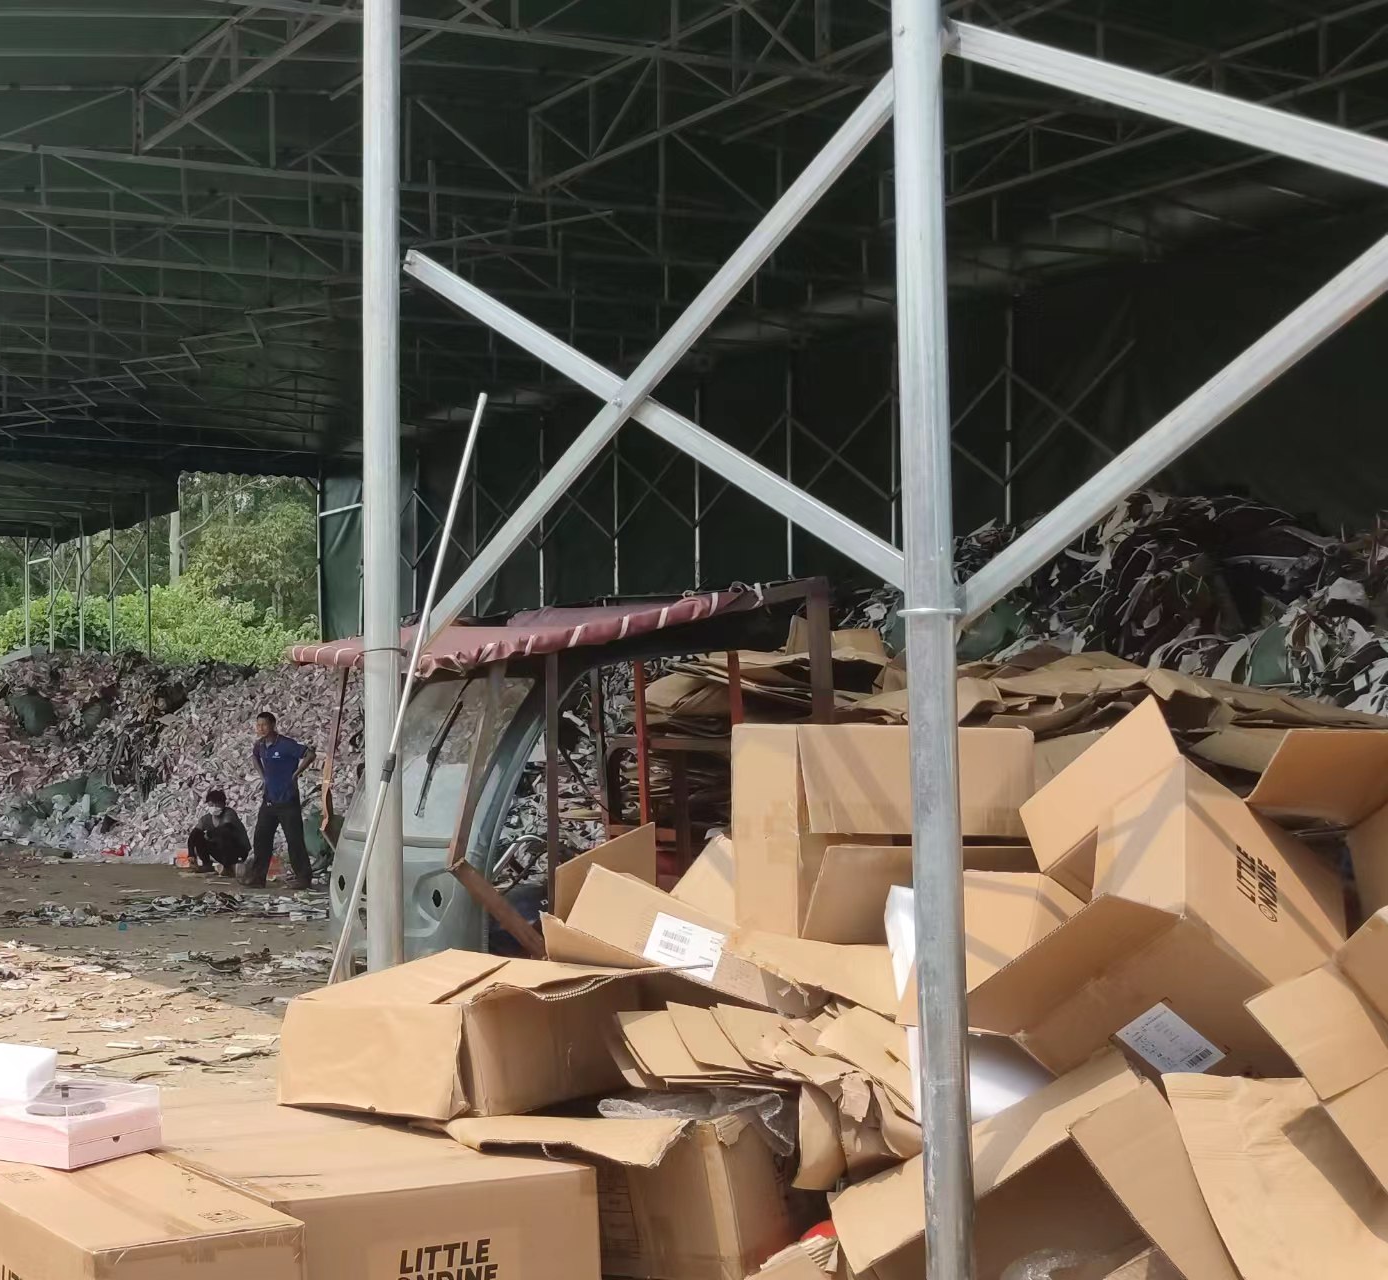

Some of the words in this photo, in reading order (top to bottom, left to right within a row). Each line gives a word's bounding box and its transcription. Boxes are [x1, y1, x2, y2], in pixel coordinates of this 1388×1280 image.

[1236, 844, 1256, 904] LITTLE
[1257, 857, 1278, 923] ONDINE
[399, 1238, 491, 1275] LITTLE
